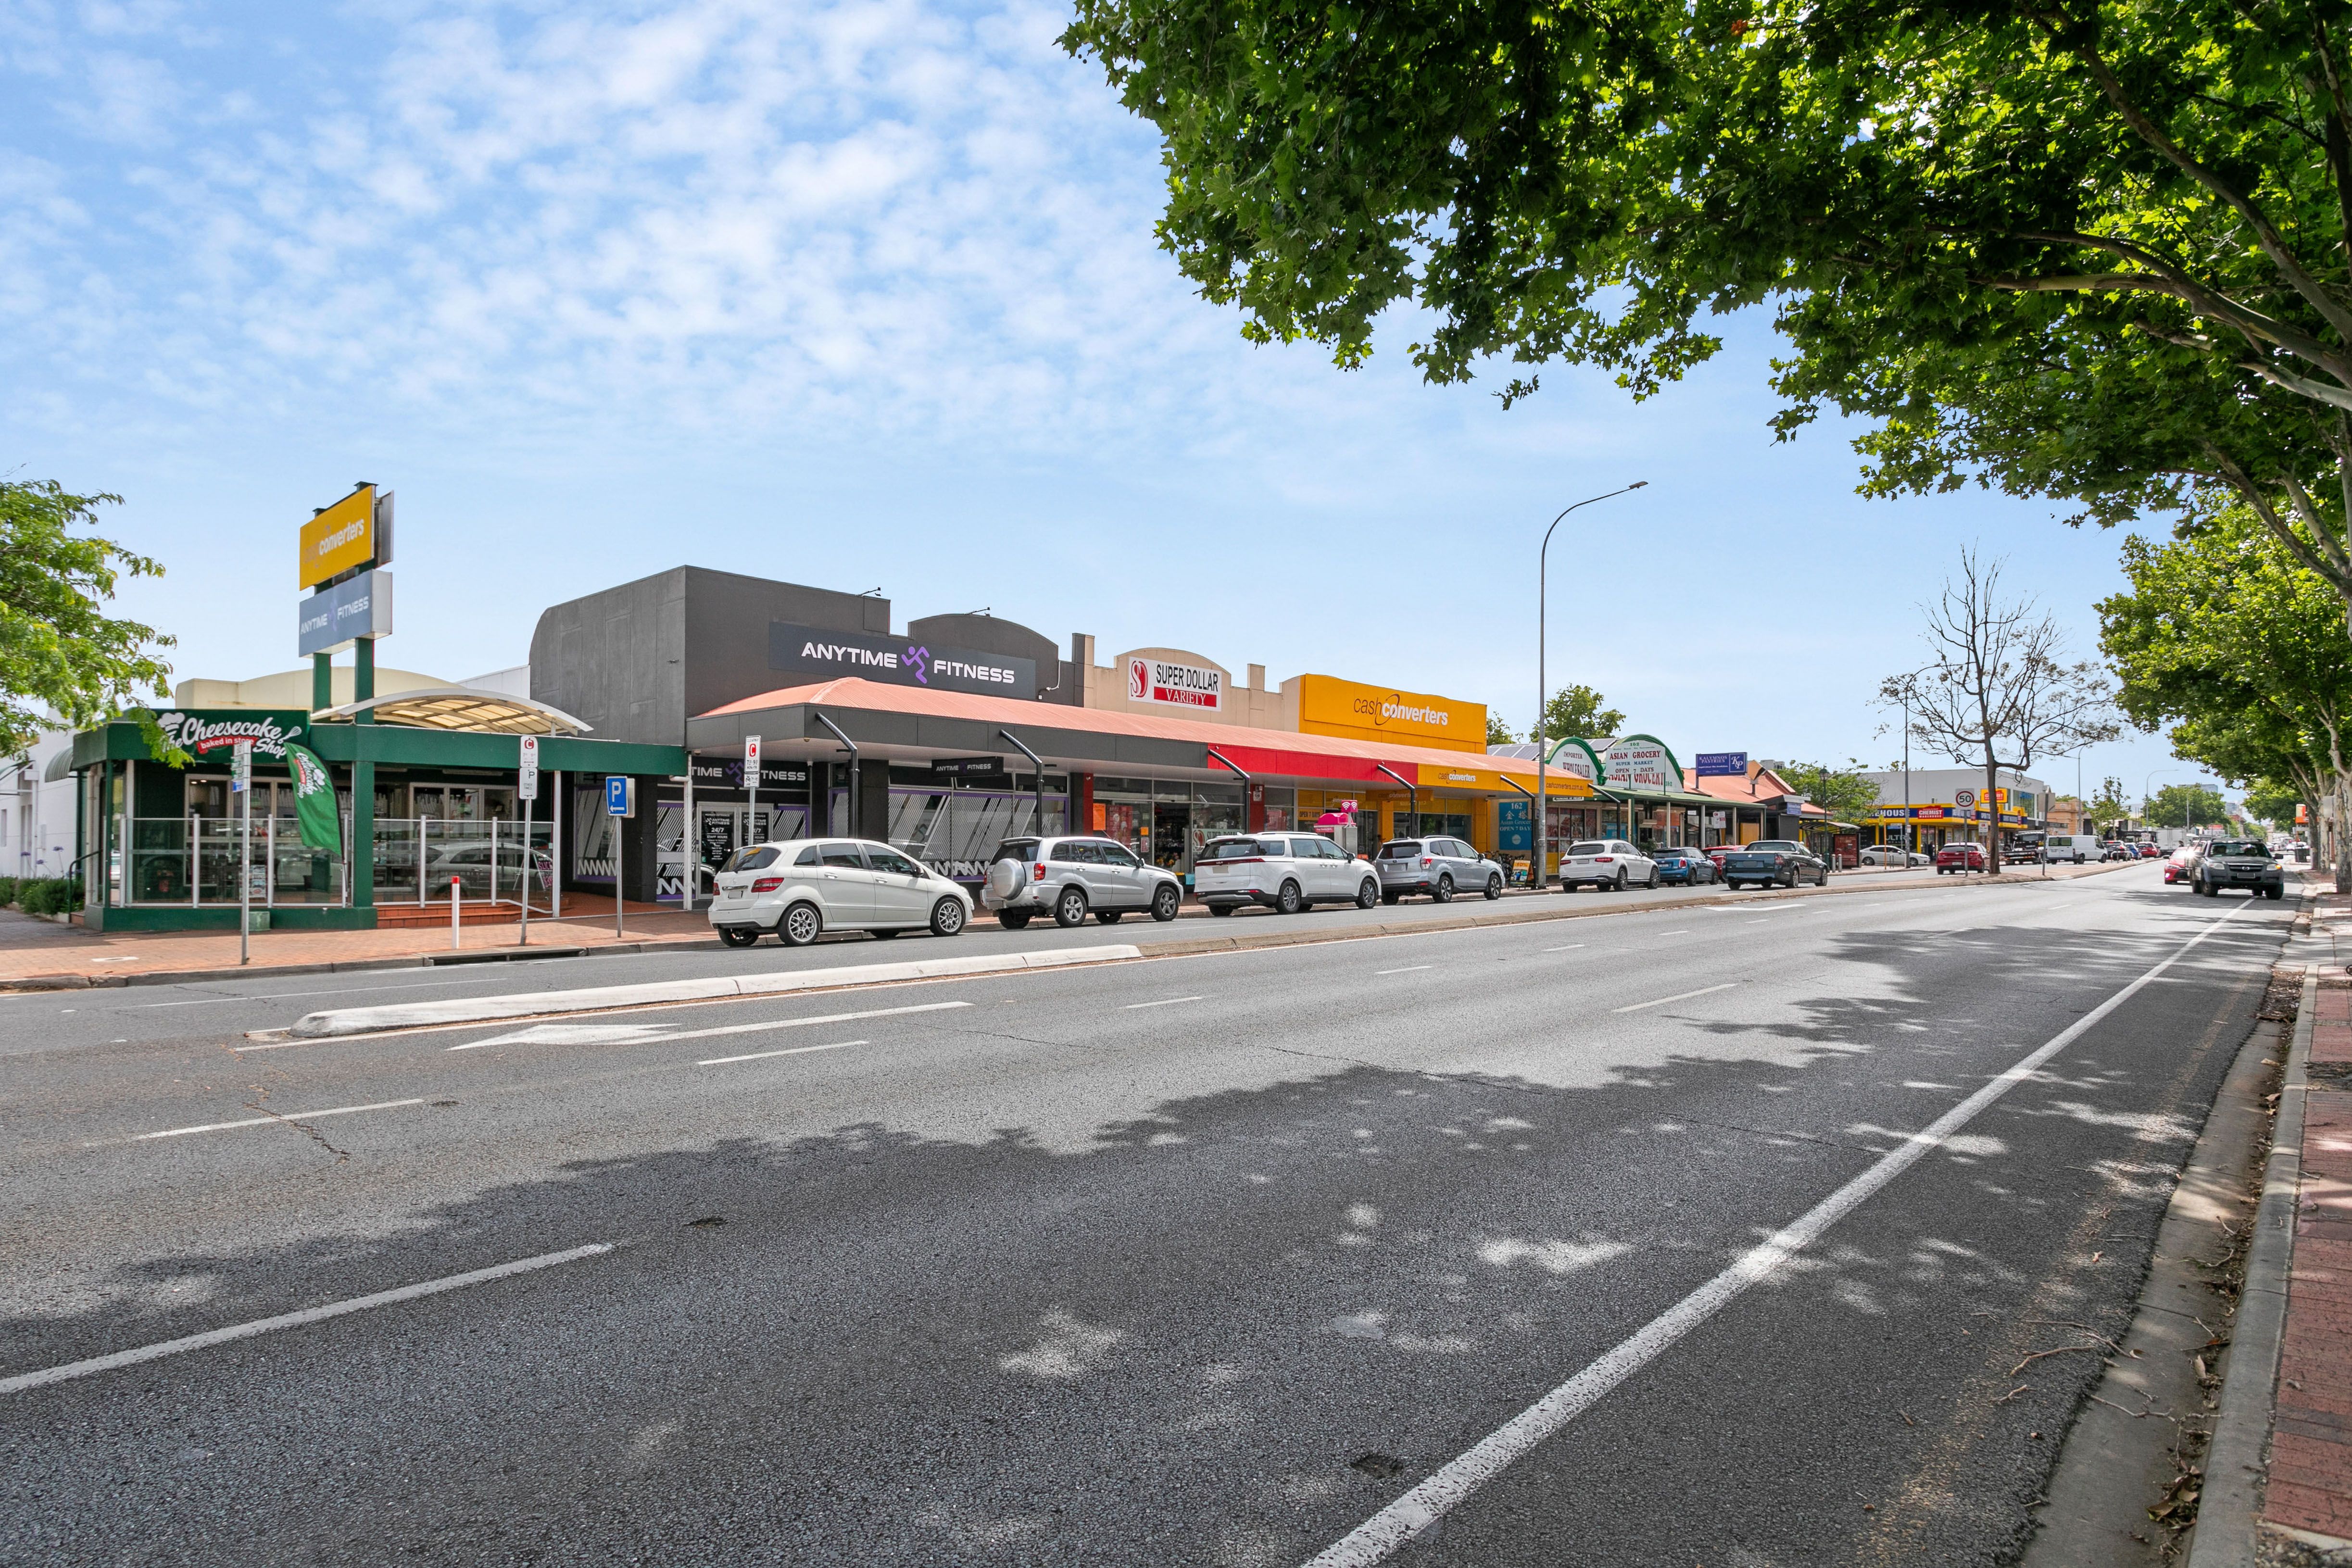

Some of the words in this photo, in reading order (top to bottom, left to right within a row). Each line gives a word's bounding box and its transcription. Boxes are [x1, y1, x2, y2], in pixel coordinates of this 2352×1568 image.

[319, 519, 364, 555] converters
[300, 613, 327, 635] ANYTIME
[337, 596, 369, 620] FITNESS
[801, 642, 897, 668] ANYTIME
[934, 659, 1015, 684] FITNESS
[1156, 664, 1184, 687] SUPER
[1186, 668, 1219, 692] DOLLAR
[1166, 689, 1206, 705] VARIETY
[182, 717, 282, 745] Cheesecake
[252, 738, 287, 759] Shop
[201, 739, 224, 749] baked
[1633, 751, 1660, 759] GROCERY
[692, 766, 722, 777] TIME
[760, 770, 805, 781] TNESS
[612, 781, 622, 802] P
